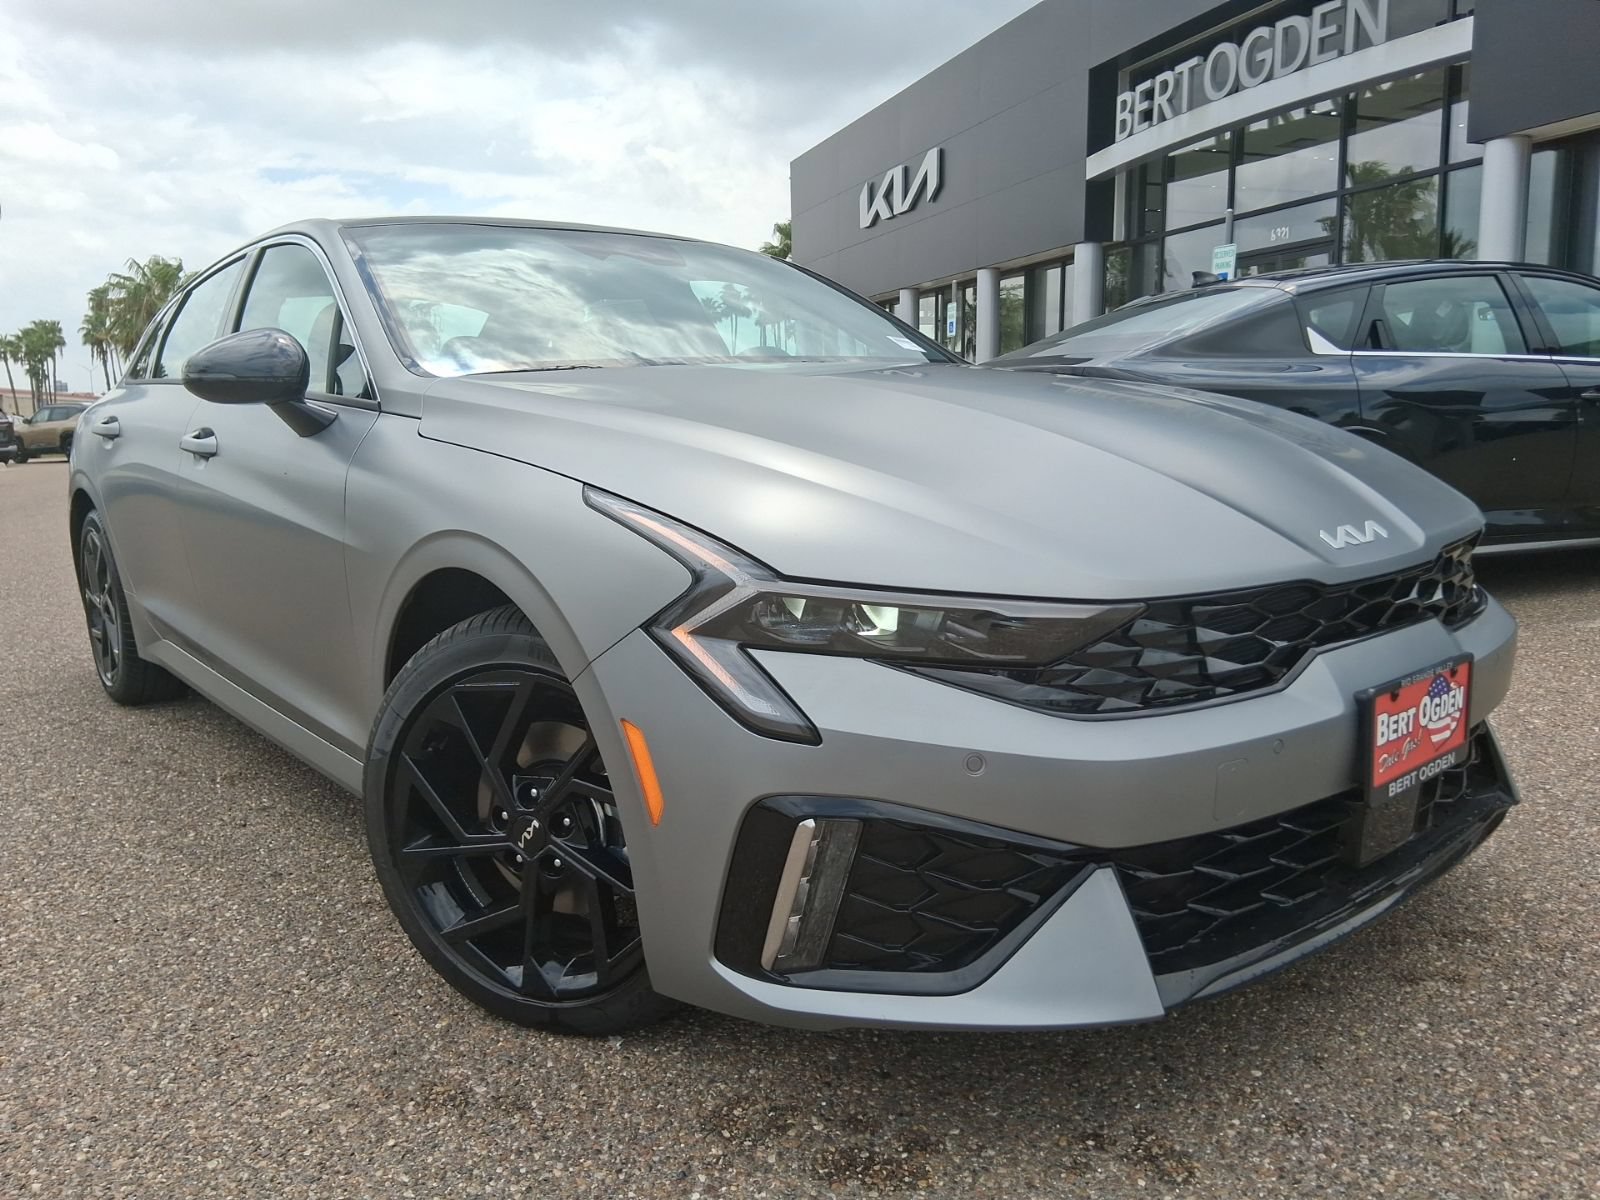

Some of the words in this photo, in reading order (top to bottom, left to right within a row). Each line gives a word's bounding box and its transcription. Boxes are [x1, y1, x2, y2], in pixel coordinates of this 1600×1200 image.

[1115, 56, 1204, 143] BERT
[1204, 0, 1388, 101] OGDEN
[860, 146, 941, 229] KIA
[1320, 520, 1388, 549] KIA
[1376, 707, 1416, 747] BERT
[1419, 686, 1464, 727] OGDEN
[1388, 770, 1418, 797] BERT
[1418, 752, 1456, 780] OGDEN
